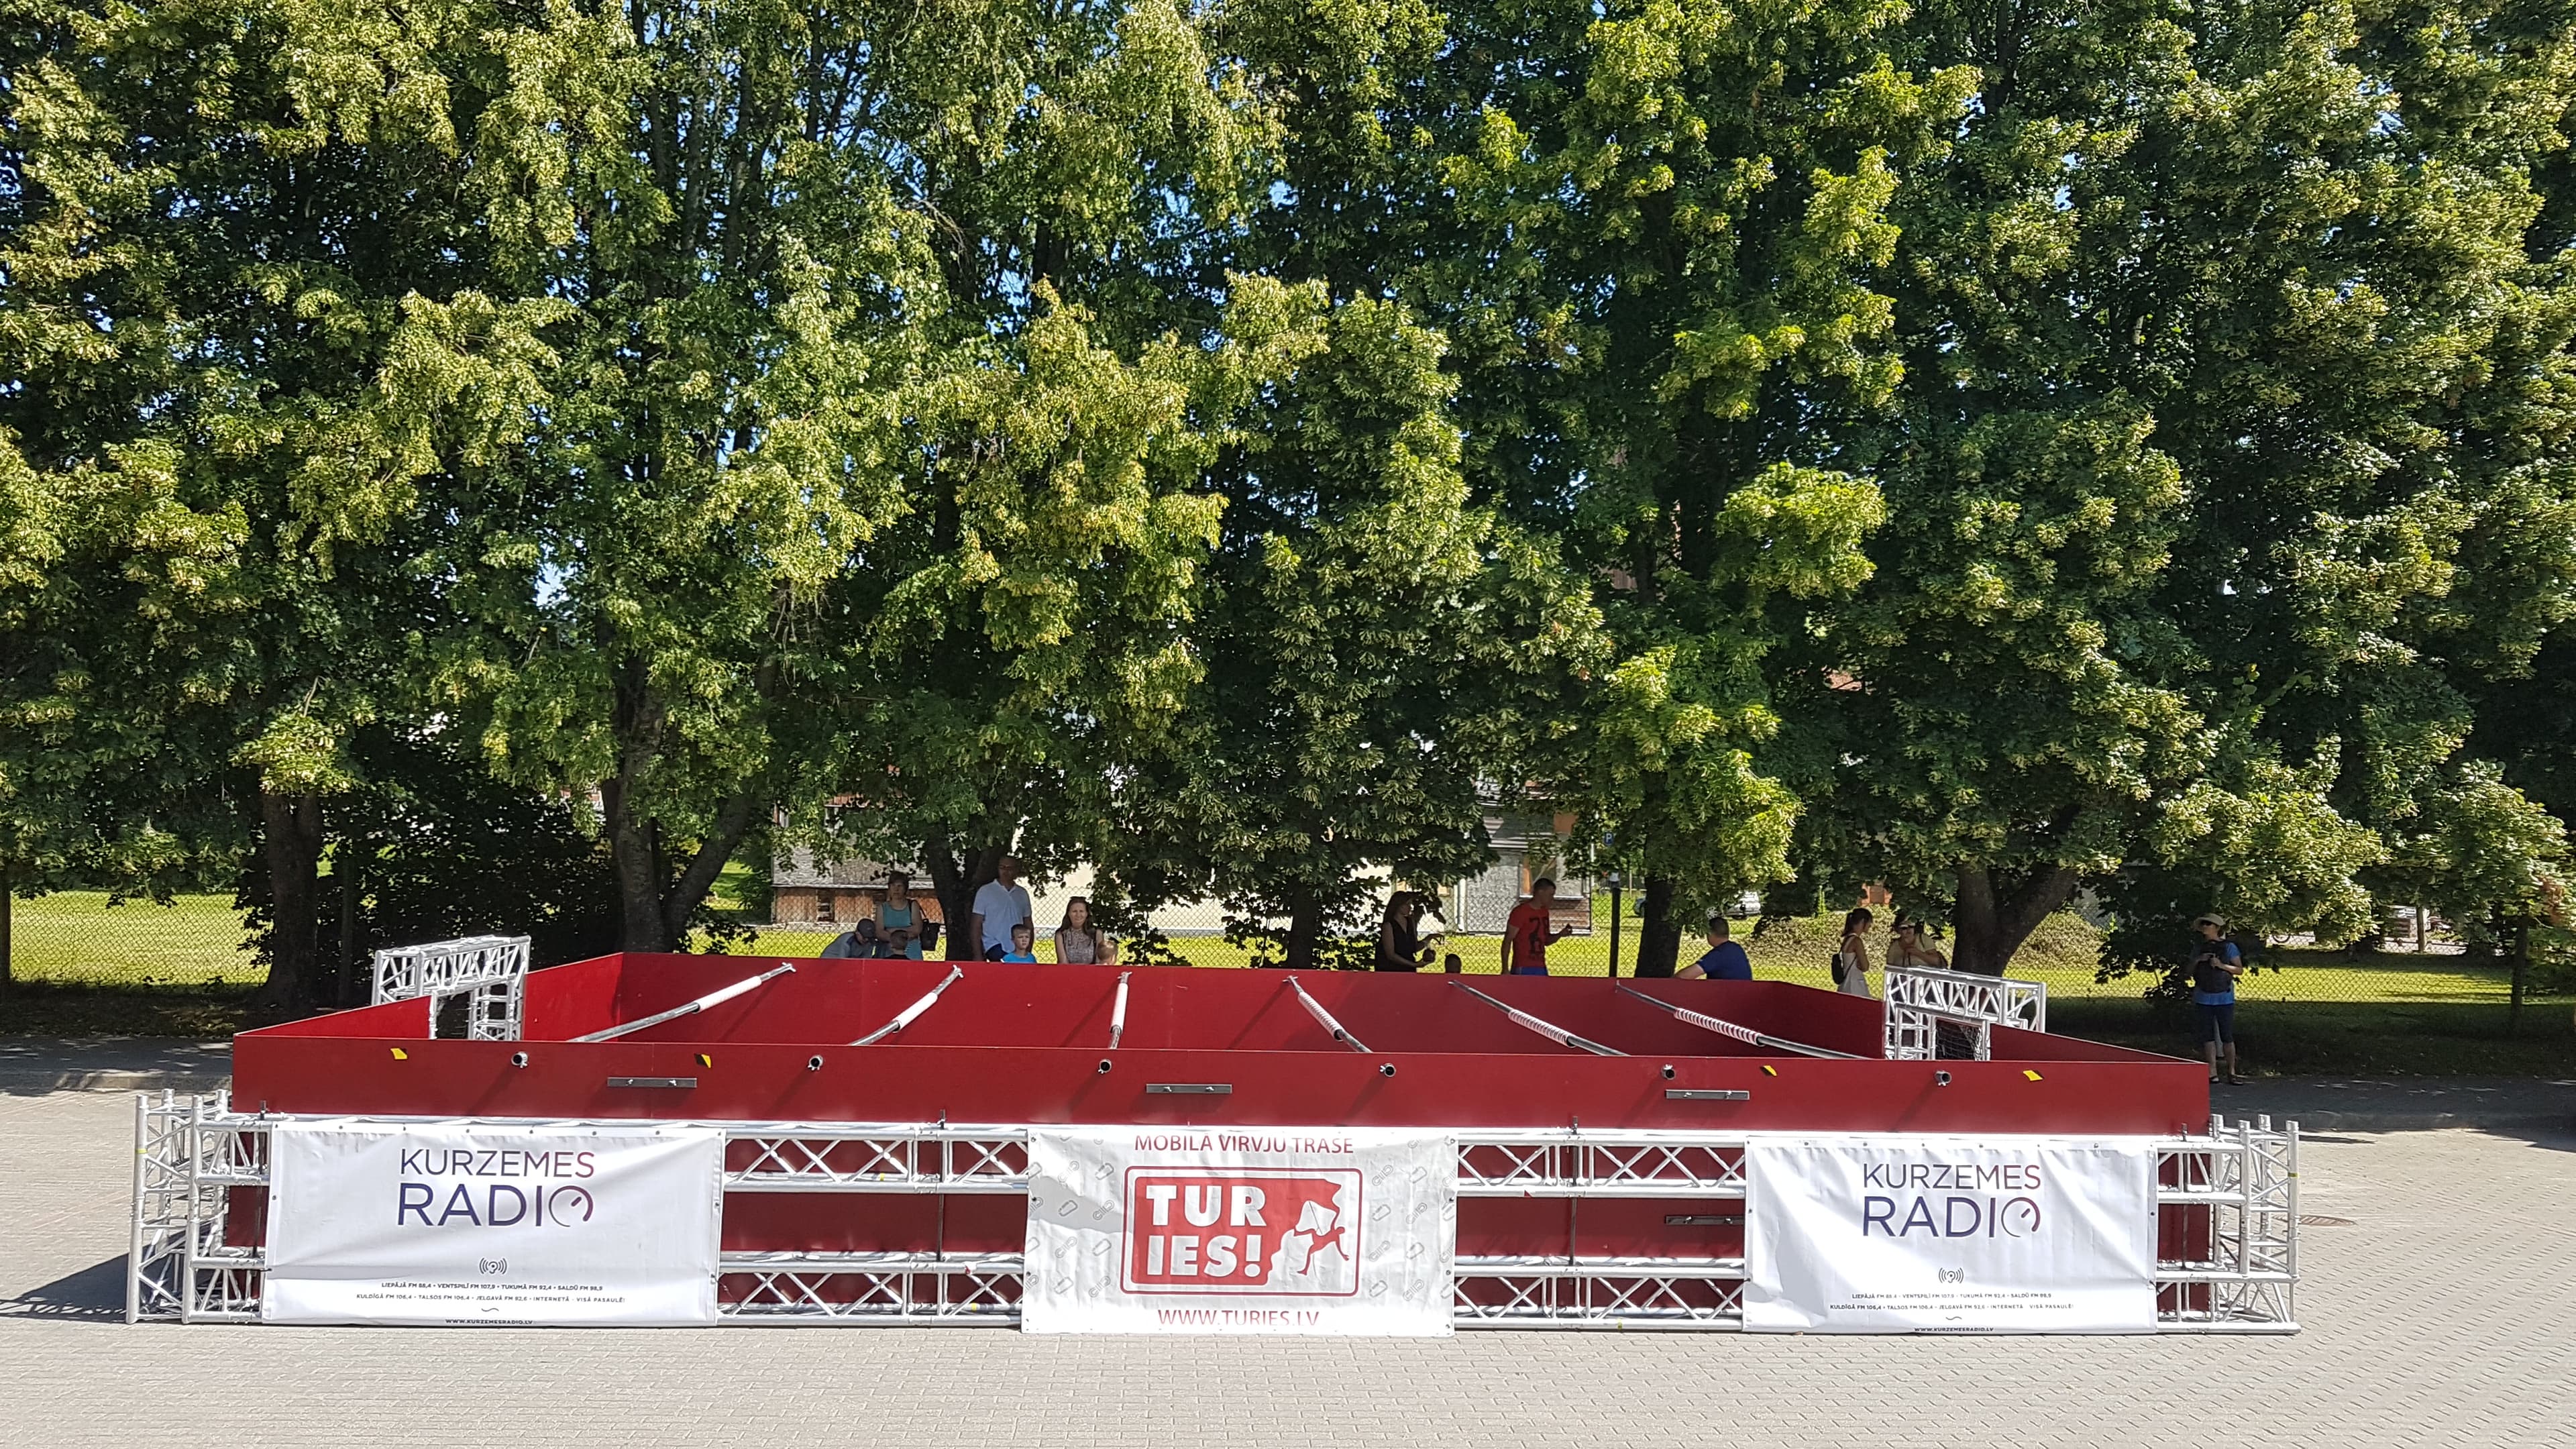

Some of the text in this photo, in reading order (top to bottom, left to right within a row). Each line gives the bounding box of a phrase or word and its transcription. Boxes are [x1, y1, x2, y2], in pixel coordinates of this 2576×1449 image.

[1218, 1136, 1286, 1152] VIRVJU
[1292, 1137, 1354, 1154] TRASE
[400, 1148, 595, 1179] KURZEMES
[1863, 1163, 2041, 1190] KURZEMES
[396, 1183, 594, 1227] RADIO
[1146, 1185, 1267, 1227] TUR
[1862, 1196, 2041, 1238] RADIO
[1147, 1234, 1262, 1277] IES!
[1158, 1309, 1320, 1326] WWW.TURIES.LV
